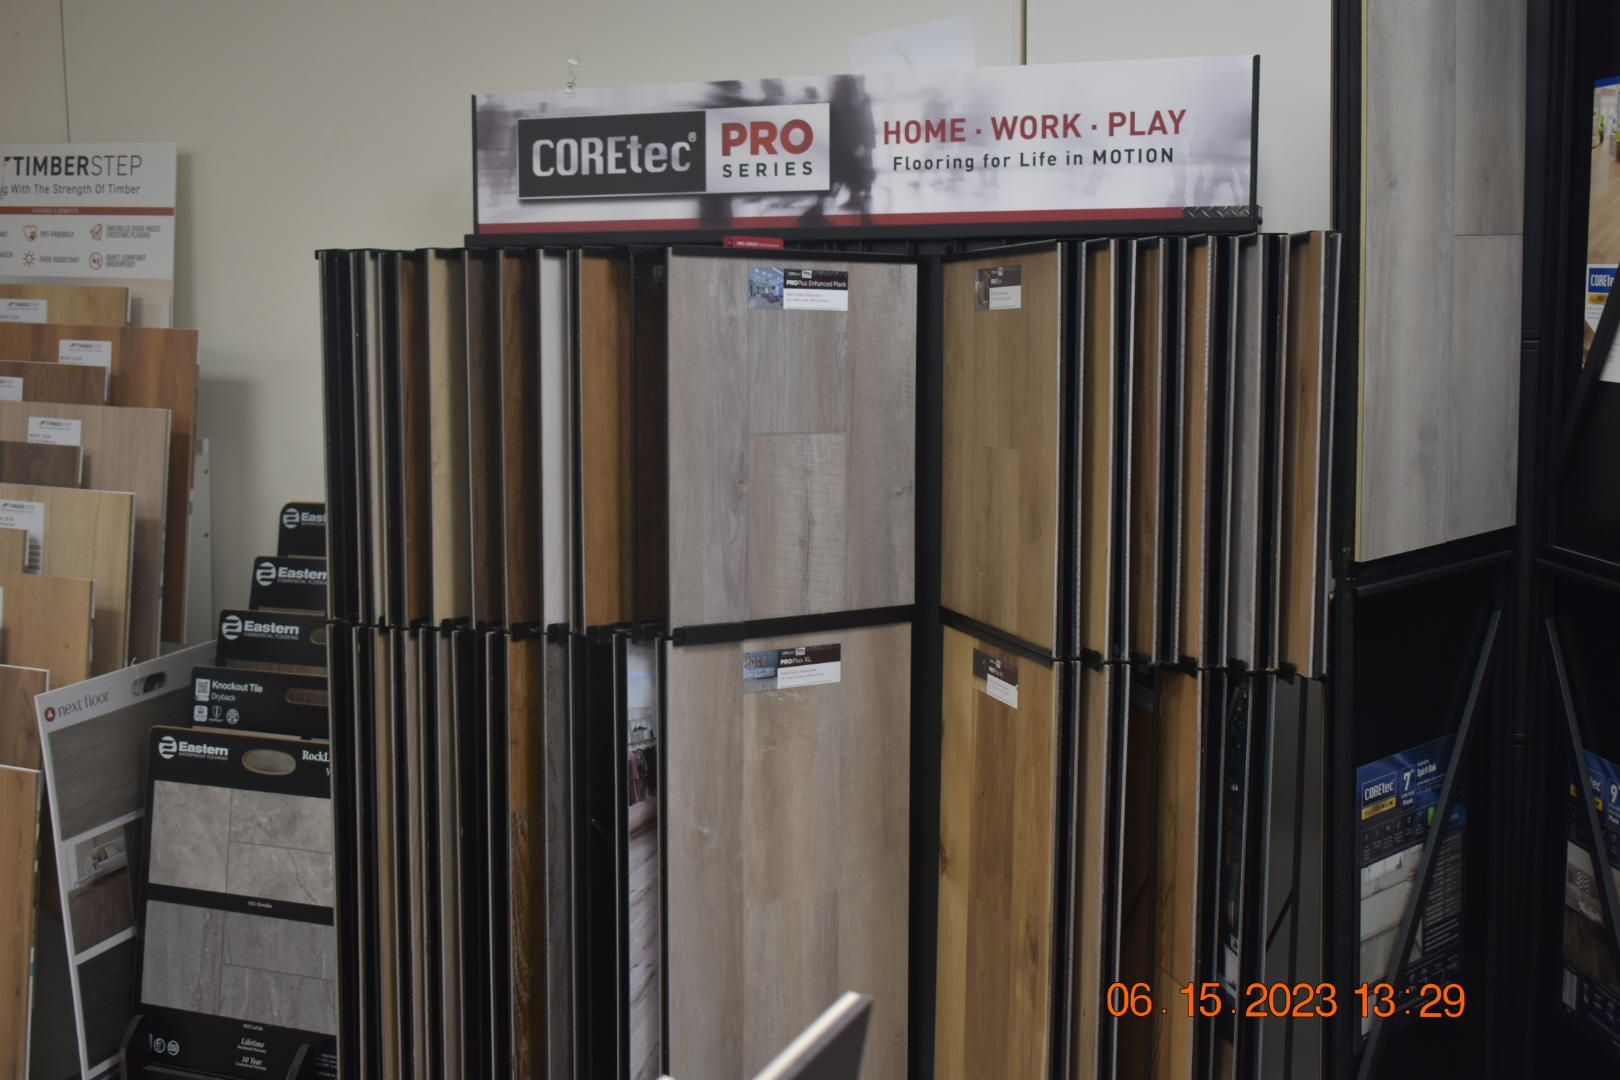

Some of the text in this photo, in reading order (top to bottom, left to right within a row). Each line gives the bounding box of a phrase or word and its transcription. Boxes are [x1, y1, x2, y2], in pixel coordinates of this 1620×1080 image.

[883, 108, 1187, 145] HOME WORK PLAY
[721, 119, 814, 157] PRO
[531, 134, 692, 178] COREtec
[893, 147, 1174, 173] Flooring for Life in MOTION
[13, 154, 143, 177] TIMBERSTEP
[722, 161, 813, 178] SERIES
[11, 184, 31, 194] With
[34, 184, 50, 194] The
[53, 184, 92, 197] Strength
[95, 184, 105, 194] Of
[108, 183, 141, 195] Timber
[244, 620, 300, 636] Eastern
[212, 679, 264, 694] Knockout Tile
[57, 691, 110, 718] next floor
[211, 691, 236, 702] Dryback
[178, 740, 229, 757] Eastern
[1364, 781, 1394, 801] COREtec
[240, 1037, 265, 1049] Lifetime
